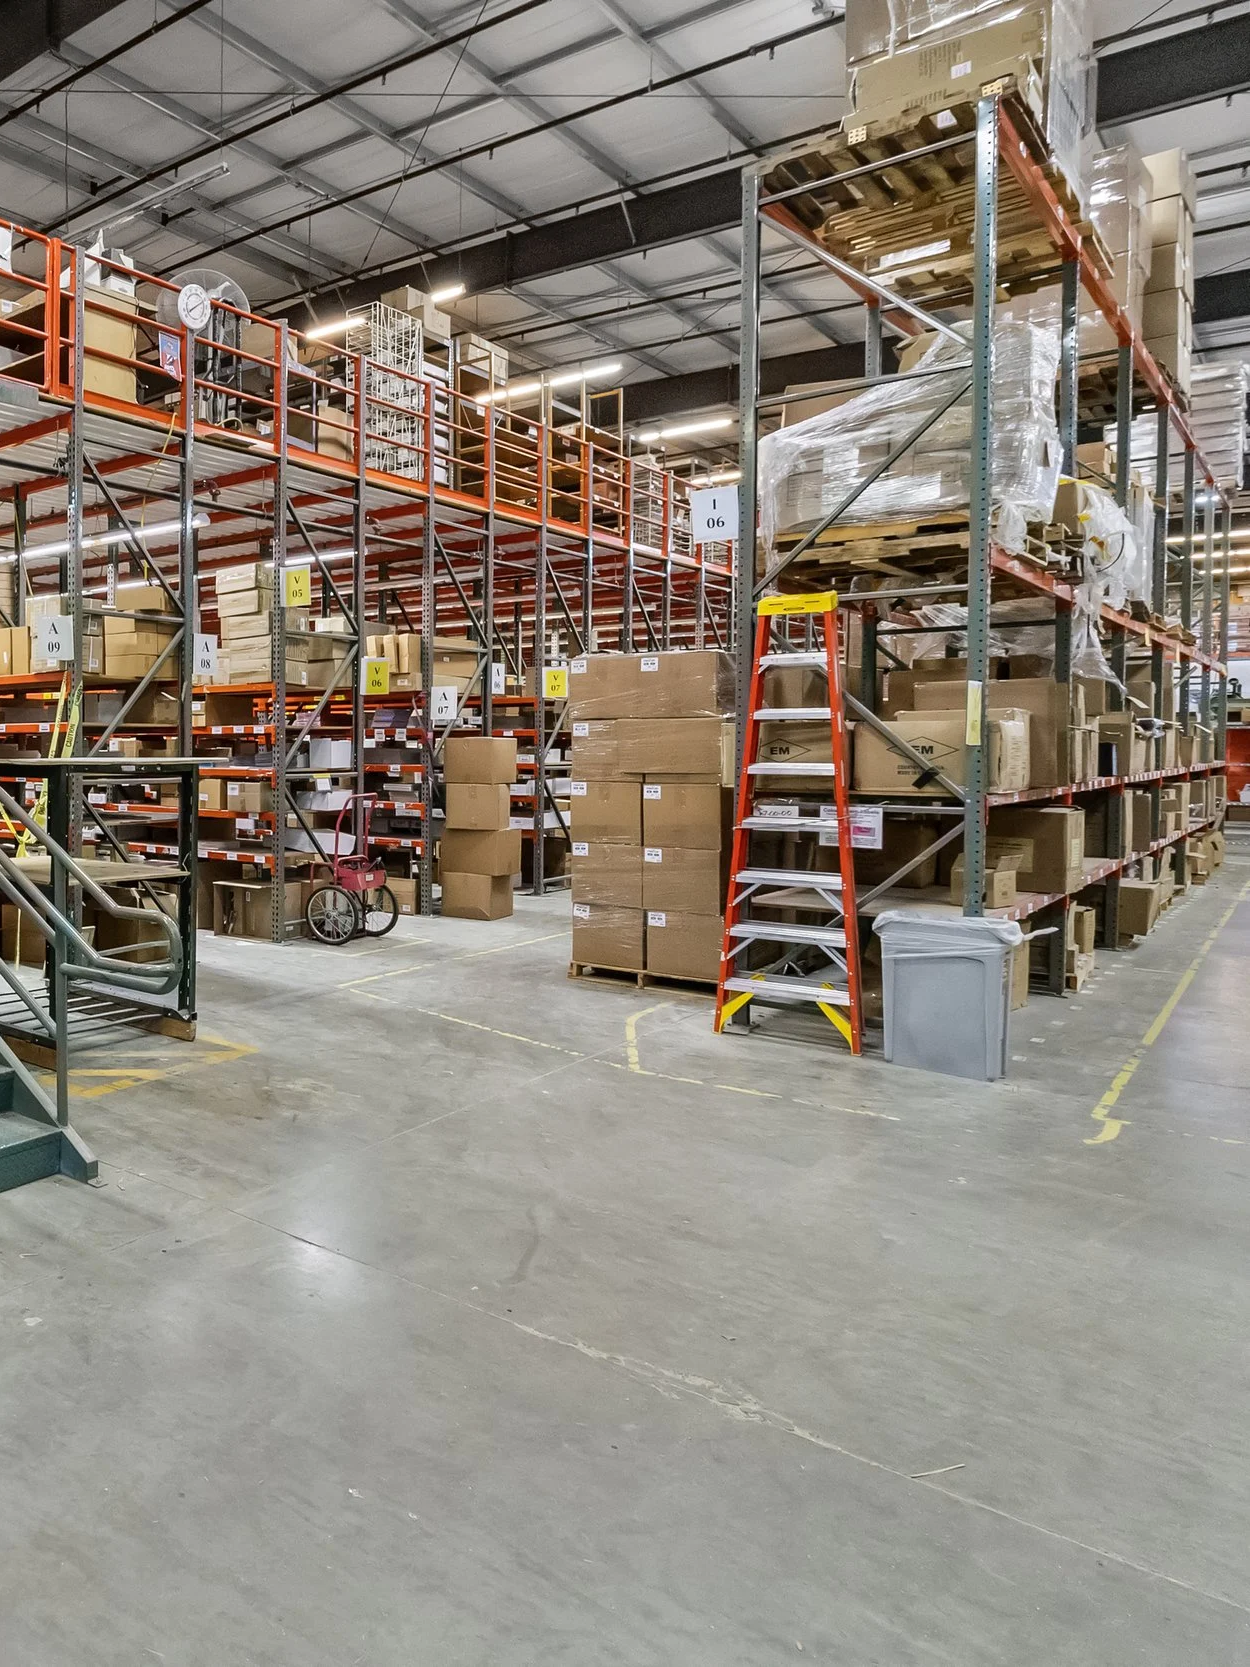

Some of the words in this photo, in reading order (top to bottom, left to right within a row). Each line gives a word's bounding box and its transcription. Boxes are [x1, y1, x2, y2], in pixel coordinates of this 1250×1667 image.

[706, 516, 725, 529] 06
[293, 576, 301, 584] V
[292, 589, 303, 598] 05
[48, 622, 59, 635] A
[47, 641, 61, 653] 09
[201, 641, 210, 653] A
[200, 658, 211, 669] 08
[374, 667, 381, 675] V
[371, 679, 382, 687] 06
[550, 684, 561, 692] 07
[439, 692, 448, 701] A
[437, 706, 449, 714] 07
[65, 723, 76, 748] CAUTION
[769, 746, 791, 755] EM
